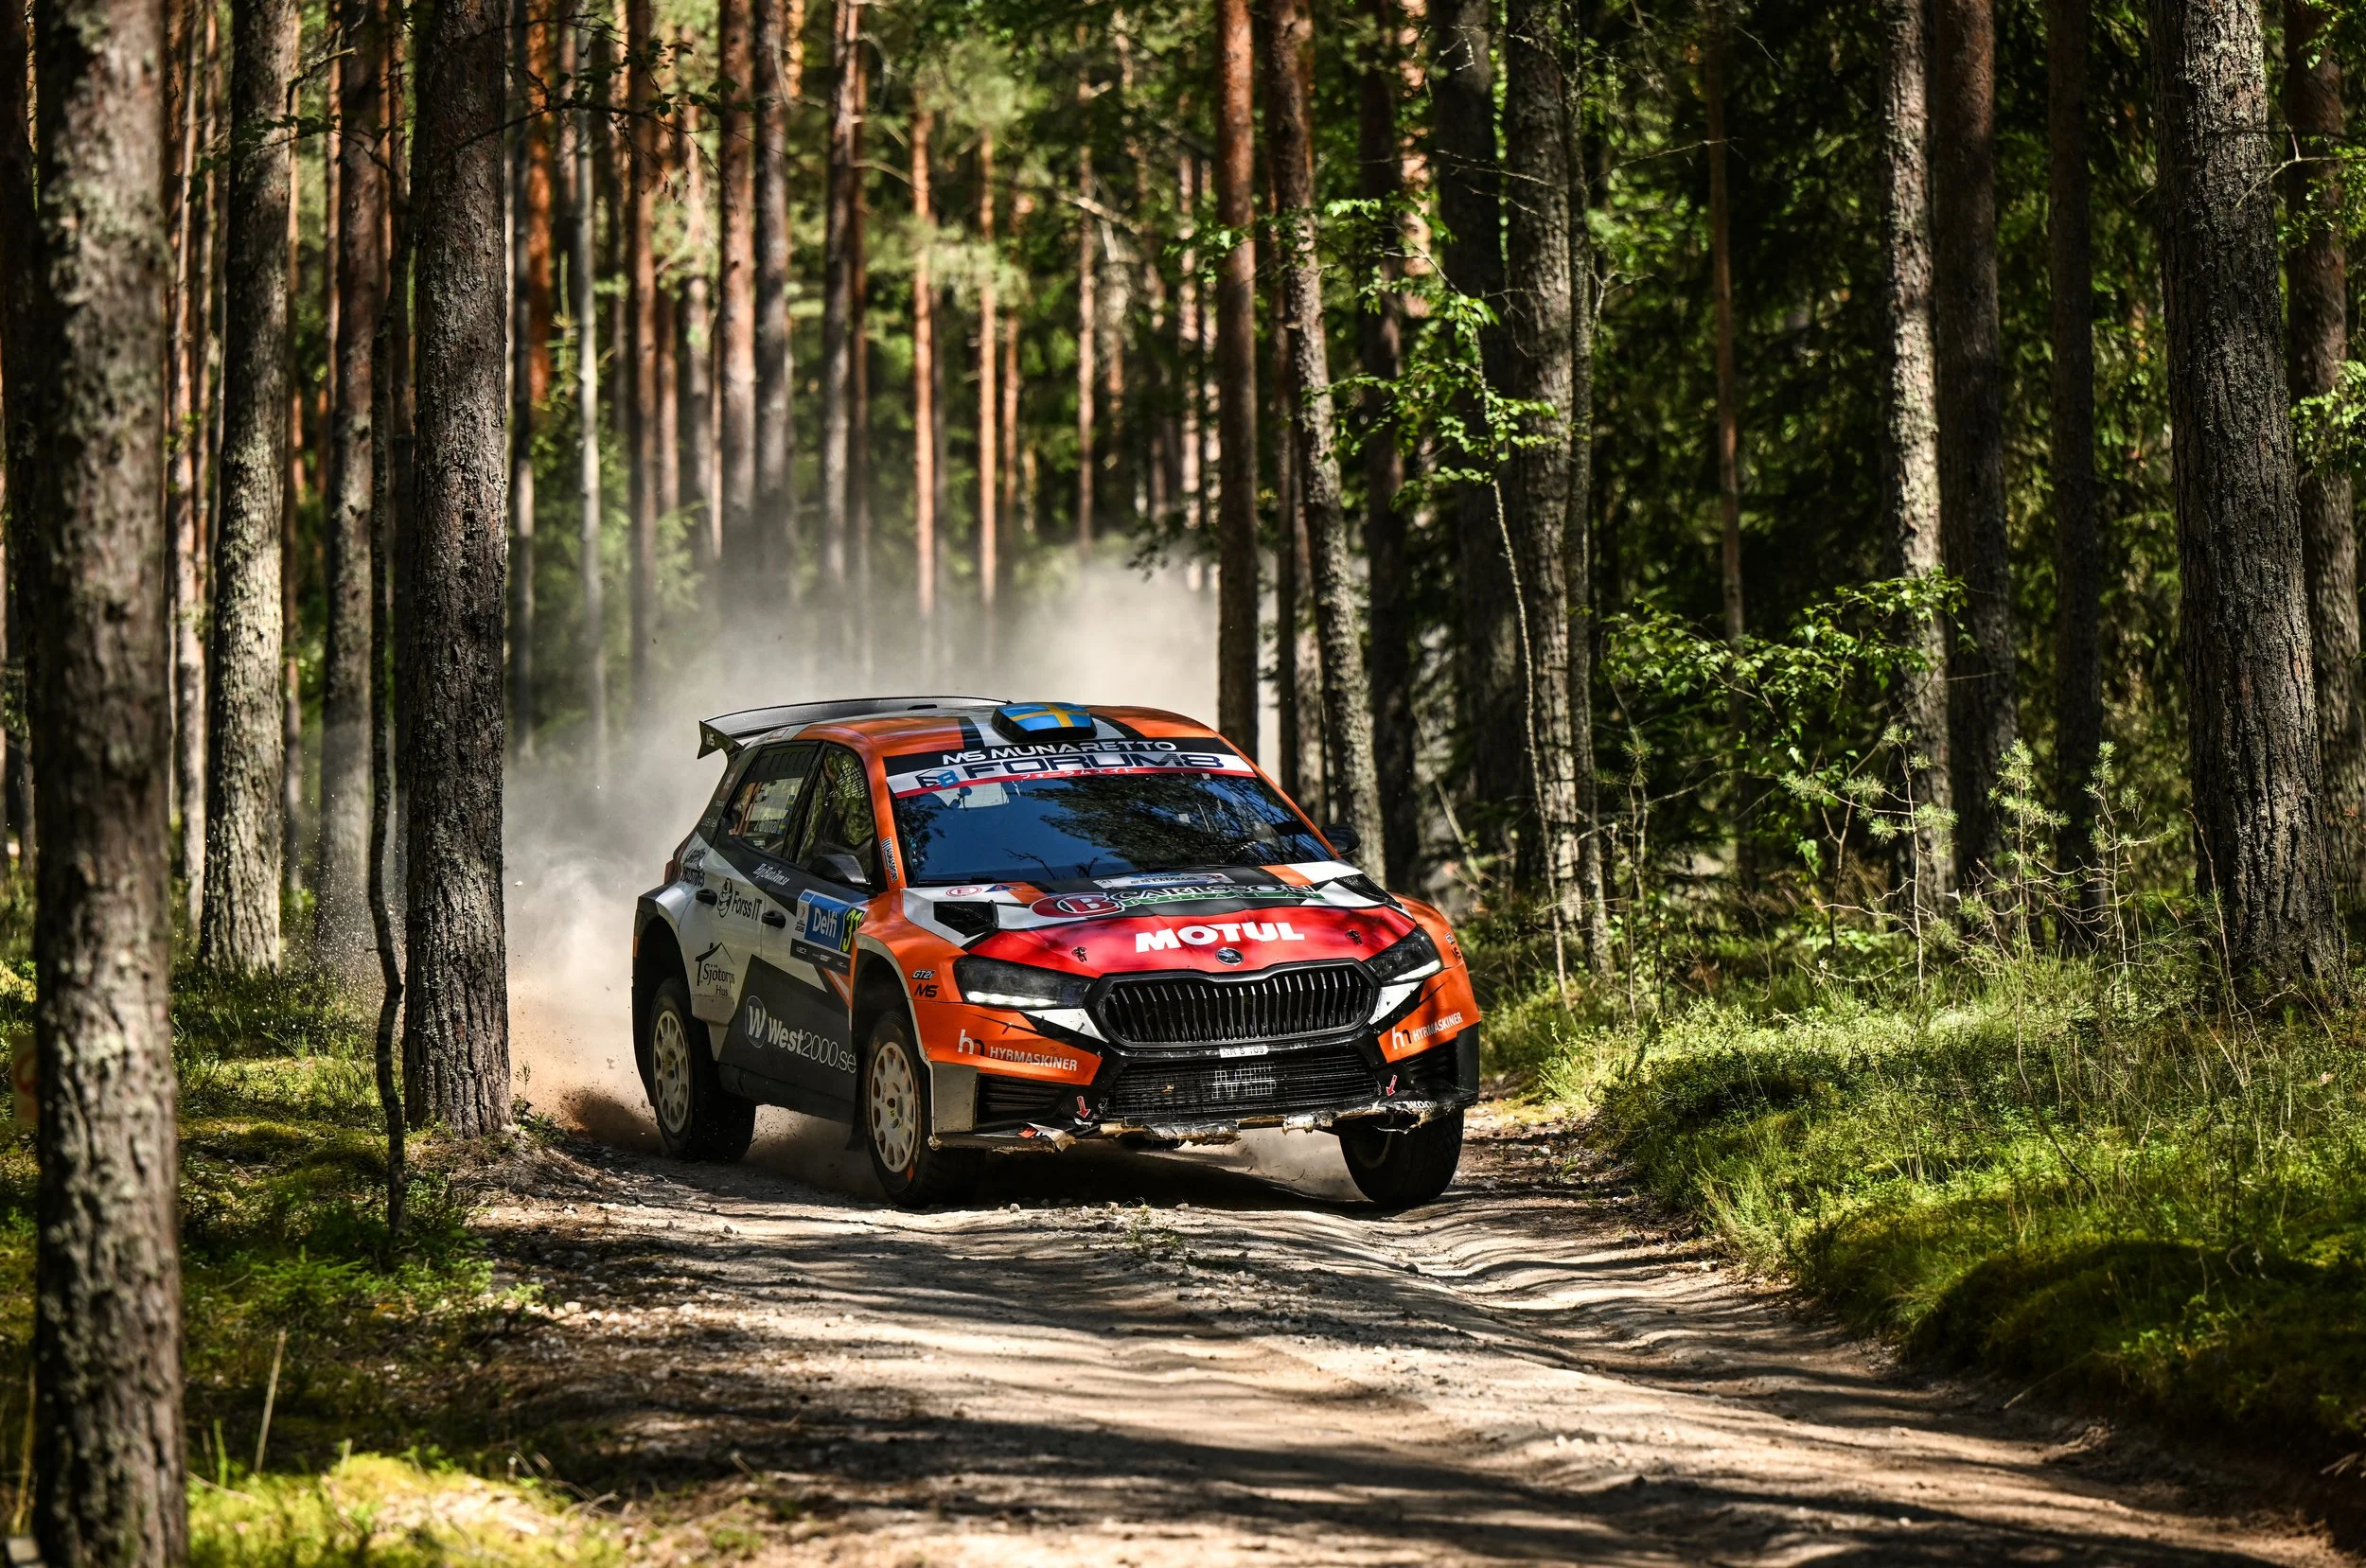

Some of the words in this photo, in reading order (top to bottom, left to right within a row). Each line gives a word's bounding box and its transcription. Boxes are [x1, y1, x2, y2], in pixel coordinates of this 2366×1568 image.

[942, 749, 987, 766] MS
[991, 741, 1177, 759] MUNARETTO
[962, 753, 1225, 780] FORUM8
[731, 890, 752, 918] Forss
[751, 897, 763, 922] IT
[1110, 884, 1317, 902] CARLSSON
[812, 907, 838, 939] Delfi
[1135, 921, 1305, 953] MOTUL
[703, 962, 735, 989] Sjötorps
[715, 984, 729, 997] Hus
[913, 983, 939, 998] MS
[1411, 1012, 1463, 1042] HYRMASKINER
[768, 1016, 856, 1074] West2000.se
[989, 1046, 1078, 1072] HYRMASKINER
